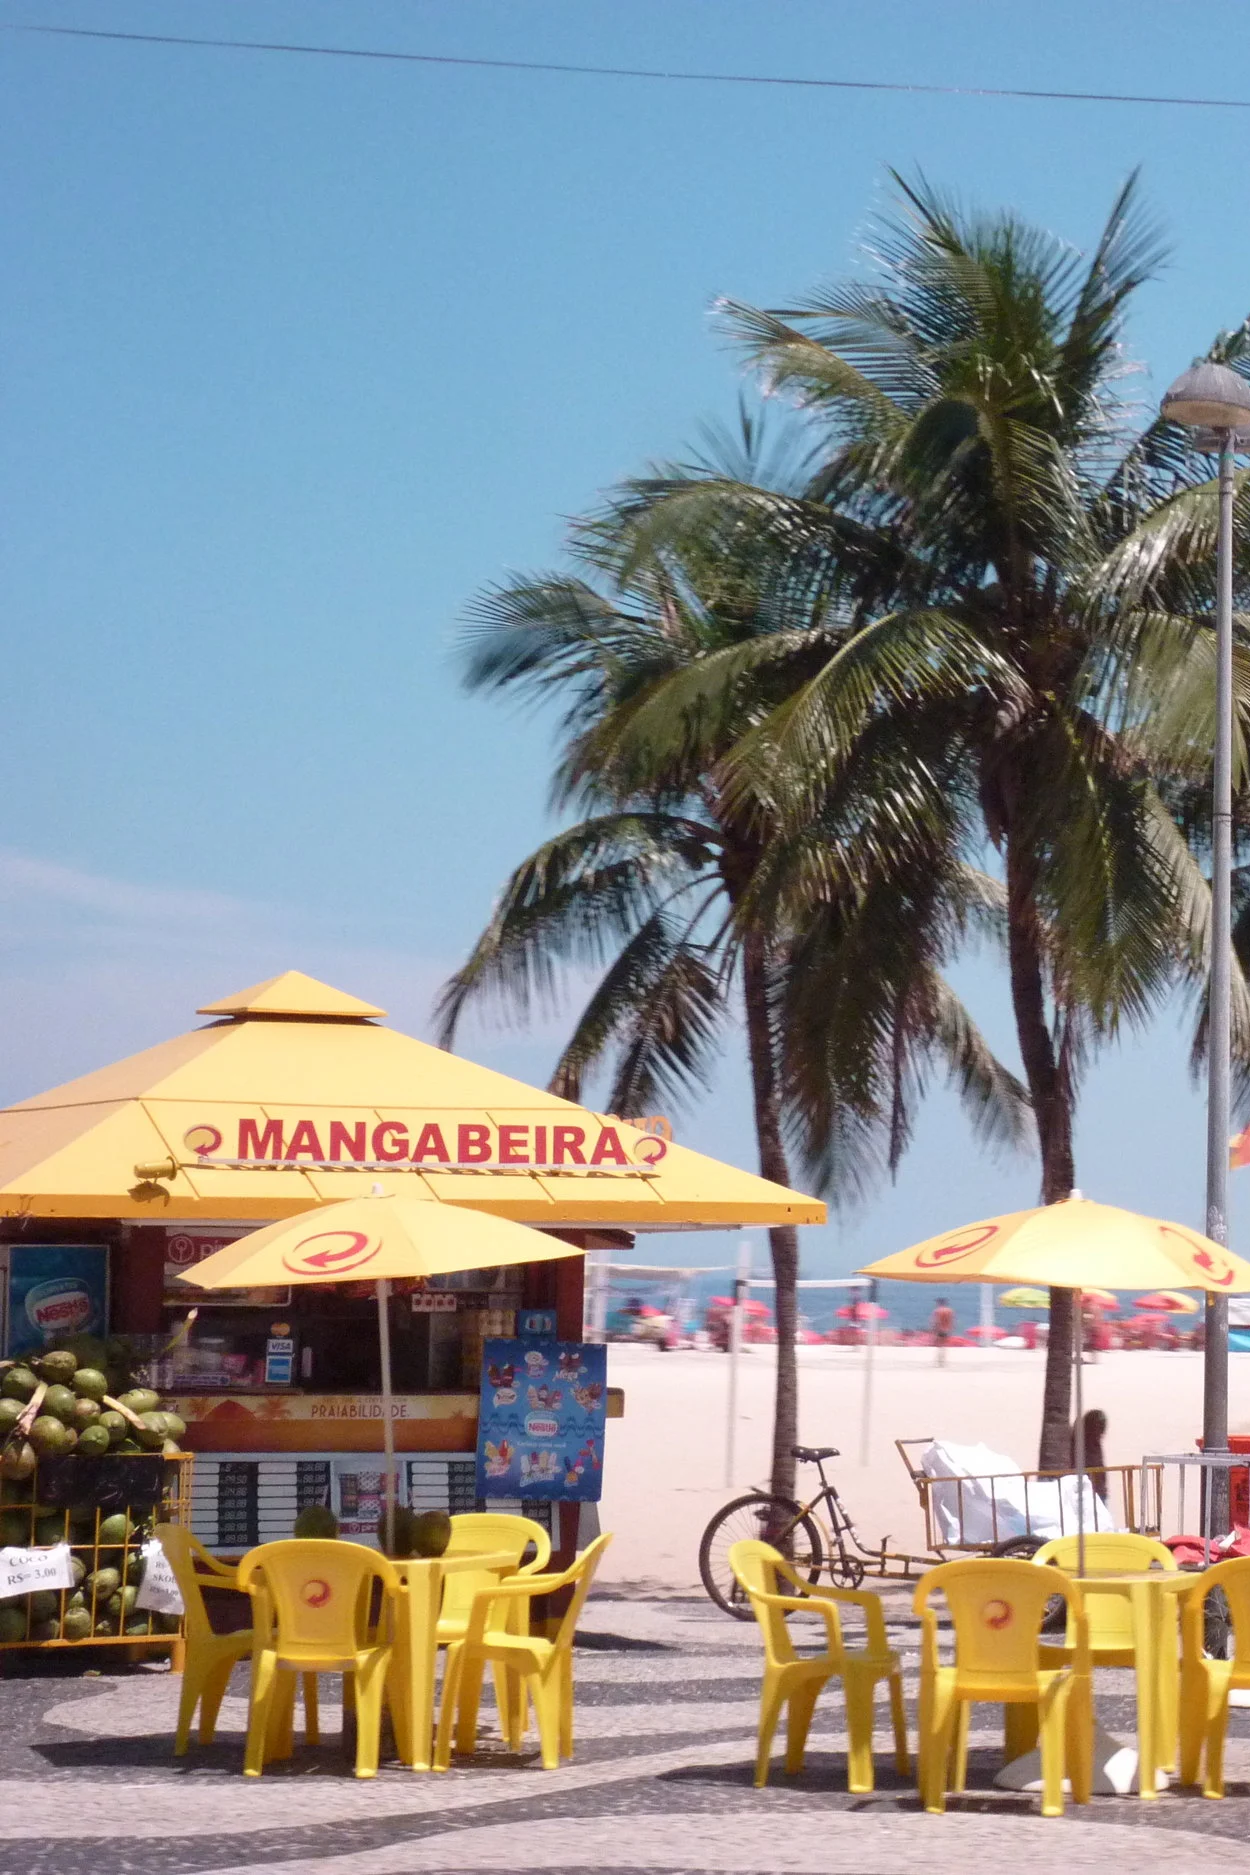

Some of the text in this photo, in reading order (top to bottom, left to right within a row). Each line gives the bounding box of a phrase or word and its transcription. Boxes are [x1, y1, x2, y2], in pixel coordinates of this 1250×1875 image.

[238, 1118, 628, 1165] MANGABEIRA
[271, 1342, 291, 1351] VISA
[311, 1404, 410, 1418] PRAIABILIDDE.
